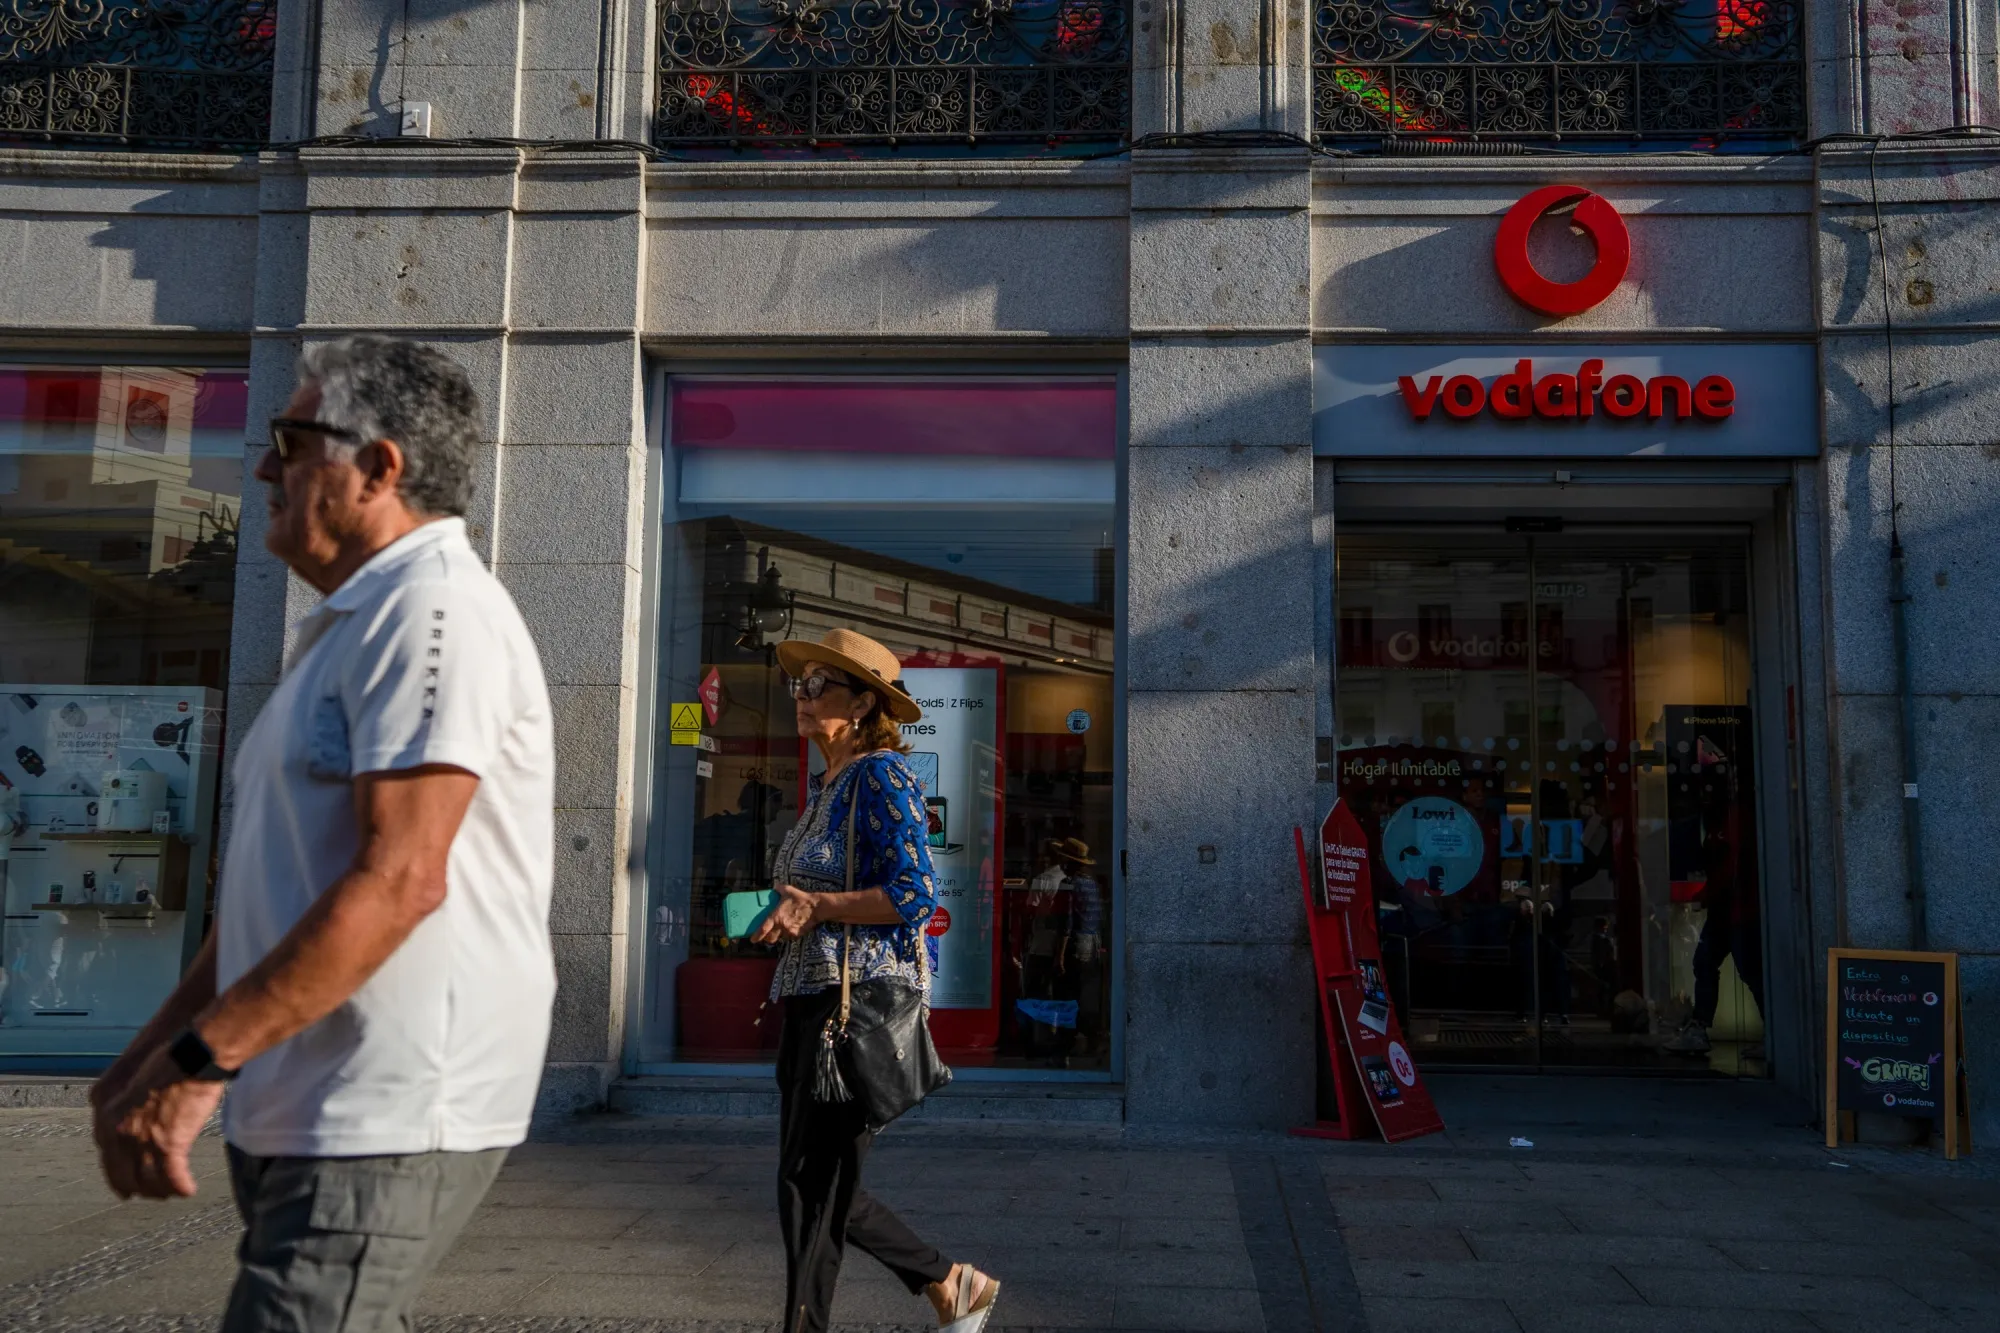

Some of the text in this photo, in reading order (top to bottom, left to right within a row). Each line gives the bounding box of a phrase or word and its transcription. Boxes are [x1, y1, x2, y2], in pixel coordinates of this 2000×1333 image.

[1397, 358, 1736, 420] vodafone
[951, 699, 957, 708] Z
[959, 698, 984, 711] Flip5
[1717, 717, 1726, 725] 14
[57, 732, 121, 740] INNOVATION
[1343, 761, 1461, 779] Hogar Ilimitable
[1412, 806, 1456, 820] Lowi
[938, 889, 950, 897] de
[1847, 967, 1881, 980] Entra
[1905, 1016, 1921, 1024] un
[1842, 1029, 1909, 1043] dispositivo
[1395, 1058, 1412, 1078] 0€
[1862, 1057, 1929, 1089] GRATIS!
[1897, 1097, 1935, 1107] vodafone
